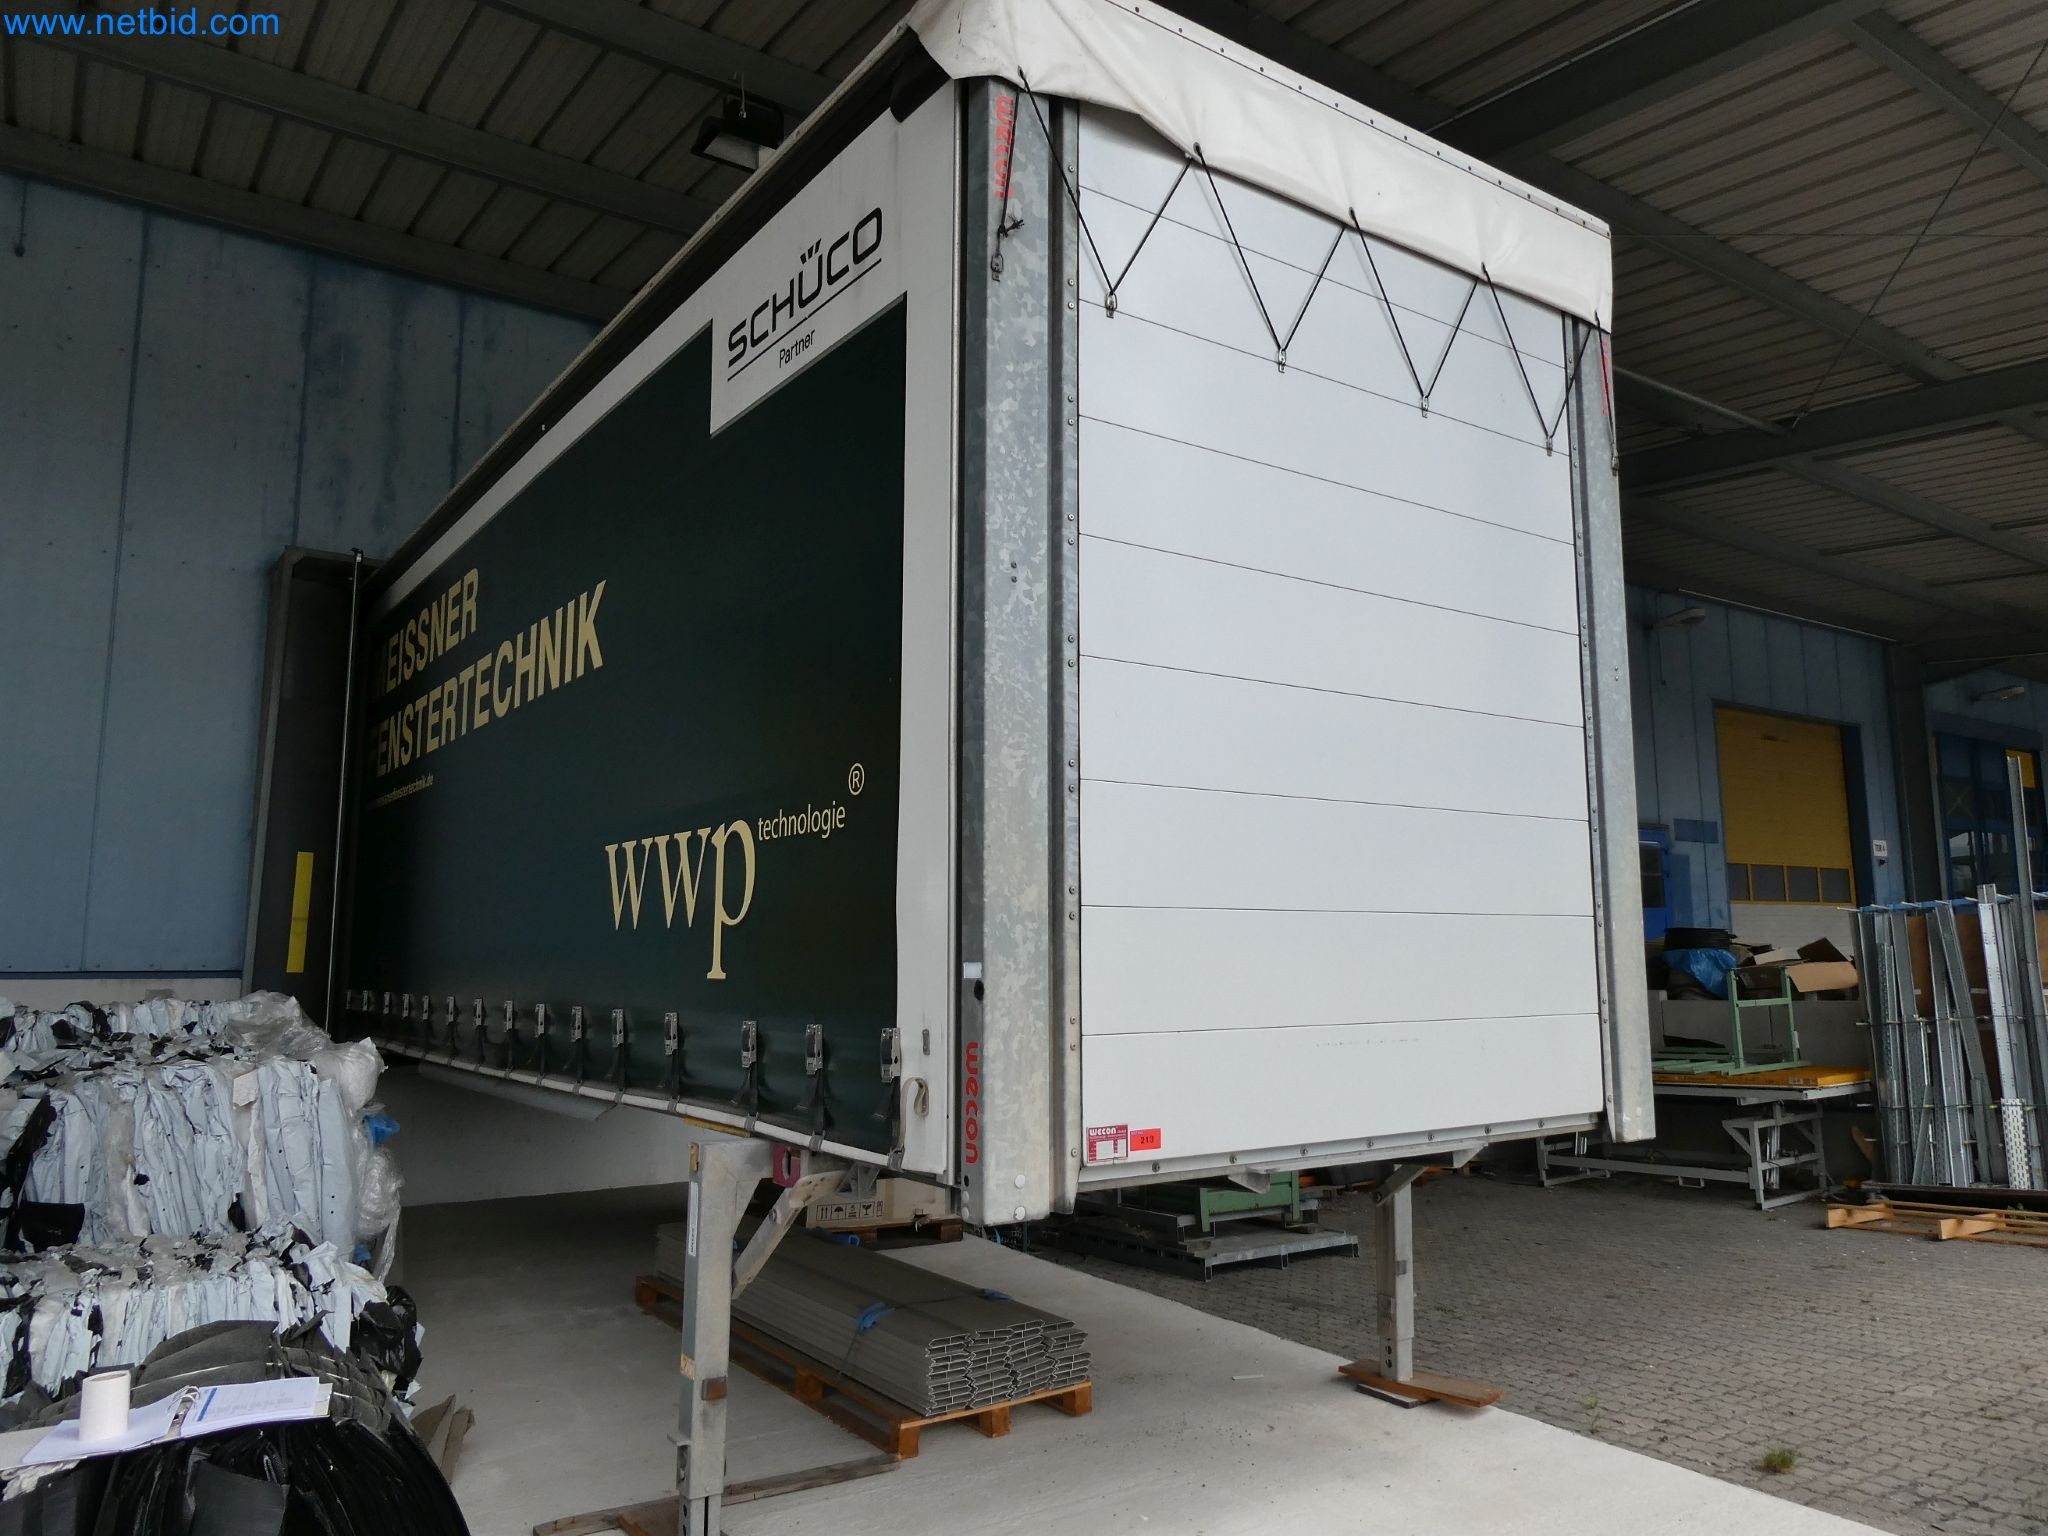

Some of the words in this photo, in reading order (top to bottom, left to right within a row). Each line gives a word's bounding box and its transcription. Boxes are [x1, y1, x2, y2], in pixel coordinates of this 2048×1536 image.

[728, 207, 882, 368] SCHÜCO
[779, 329, 815, 369] Partner
[378, 568, 479, 696] EISSNER
[605, 819, 756, 980] wwp
[758, 800, 846, 841] technologie
[1140, 1135, 1154, 1145] 213
